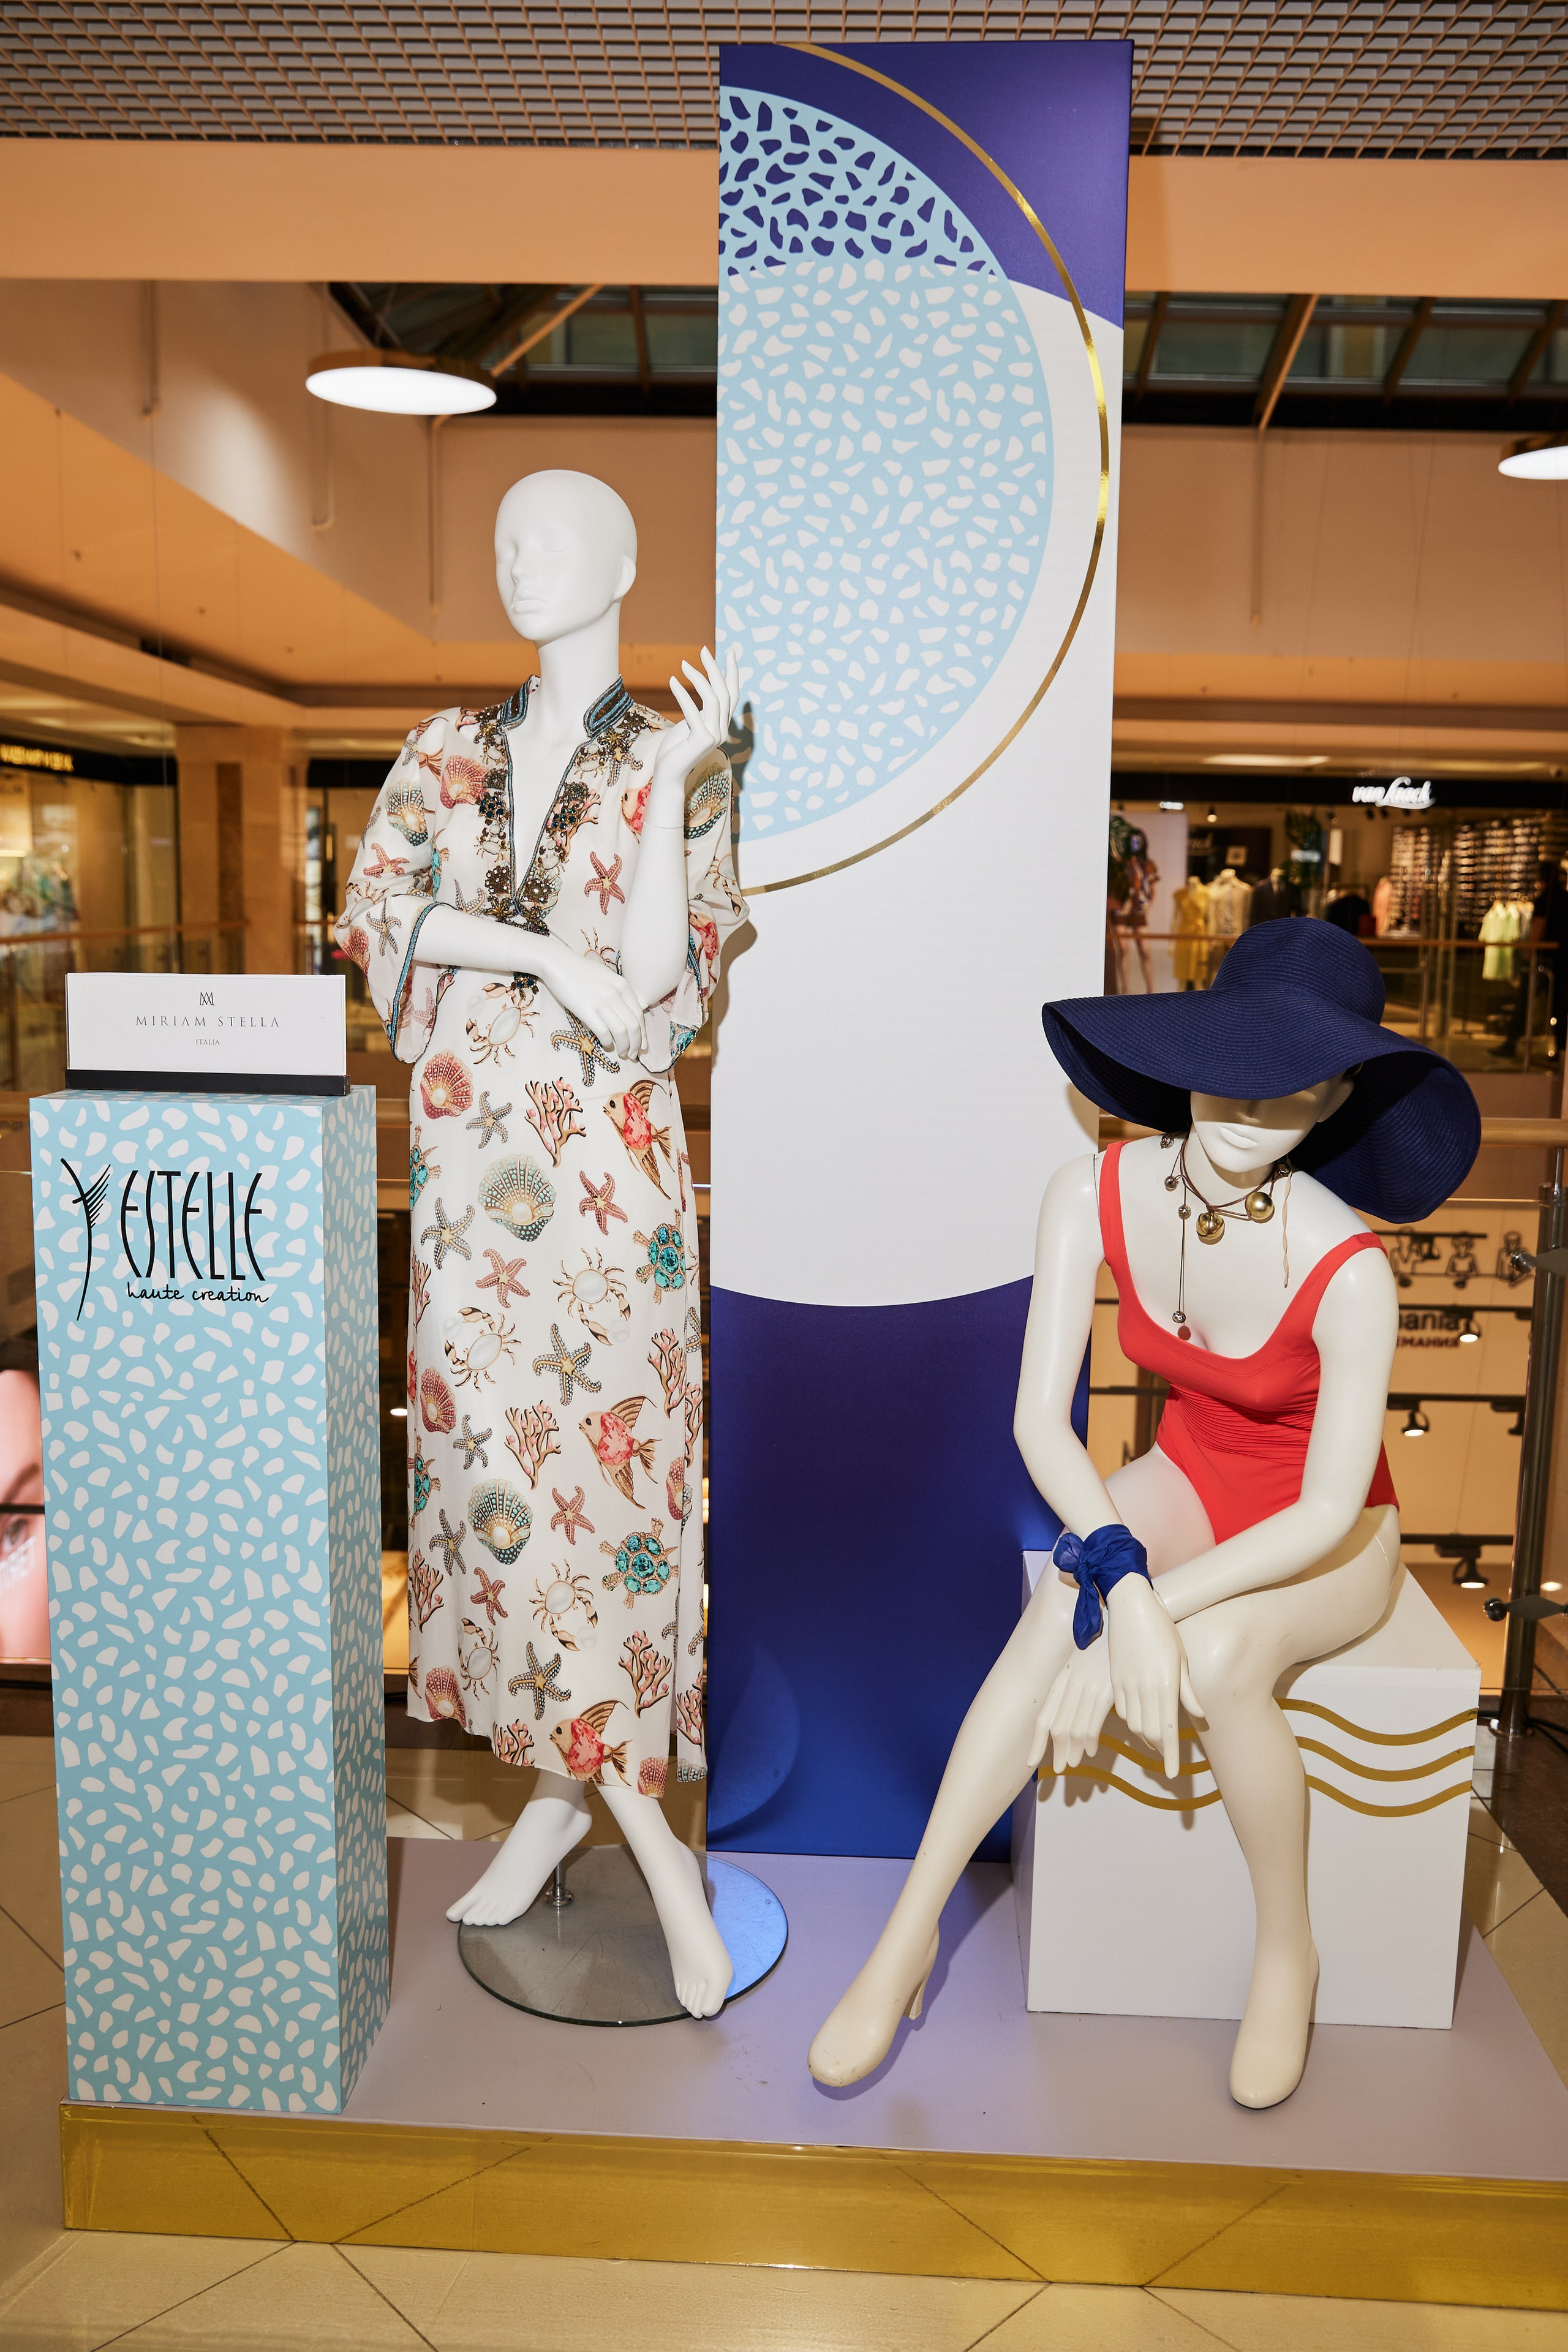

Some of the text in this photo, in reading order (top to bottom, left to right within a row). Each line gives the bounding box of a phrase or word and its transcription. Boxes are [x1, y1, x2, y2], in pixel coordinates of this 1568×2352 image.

[137, 1016, 279, 1027] MIRIAM STELLA
[127, 1282, 269, 1302] haute creation
[1399, 1313, 1459, 1330] ania
